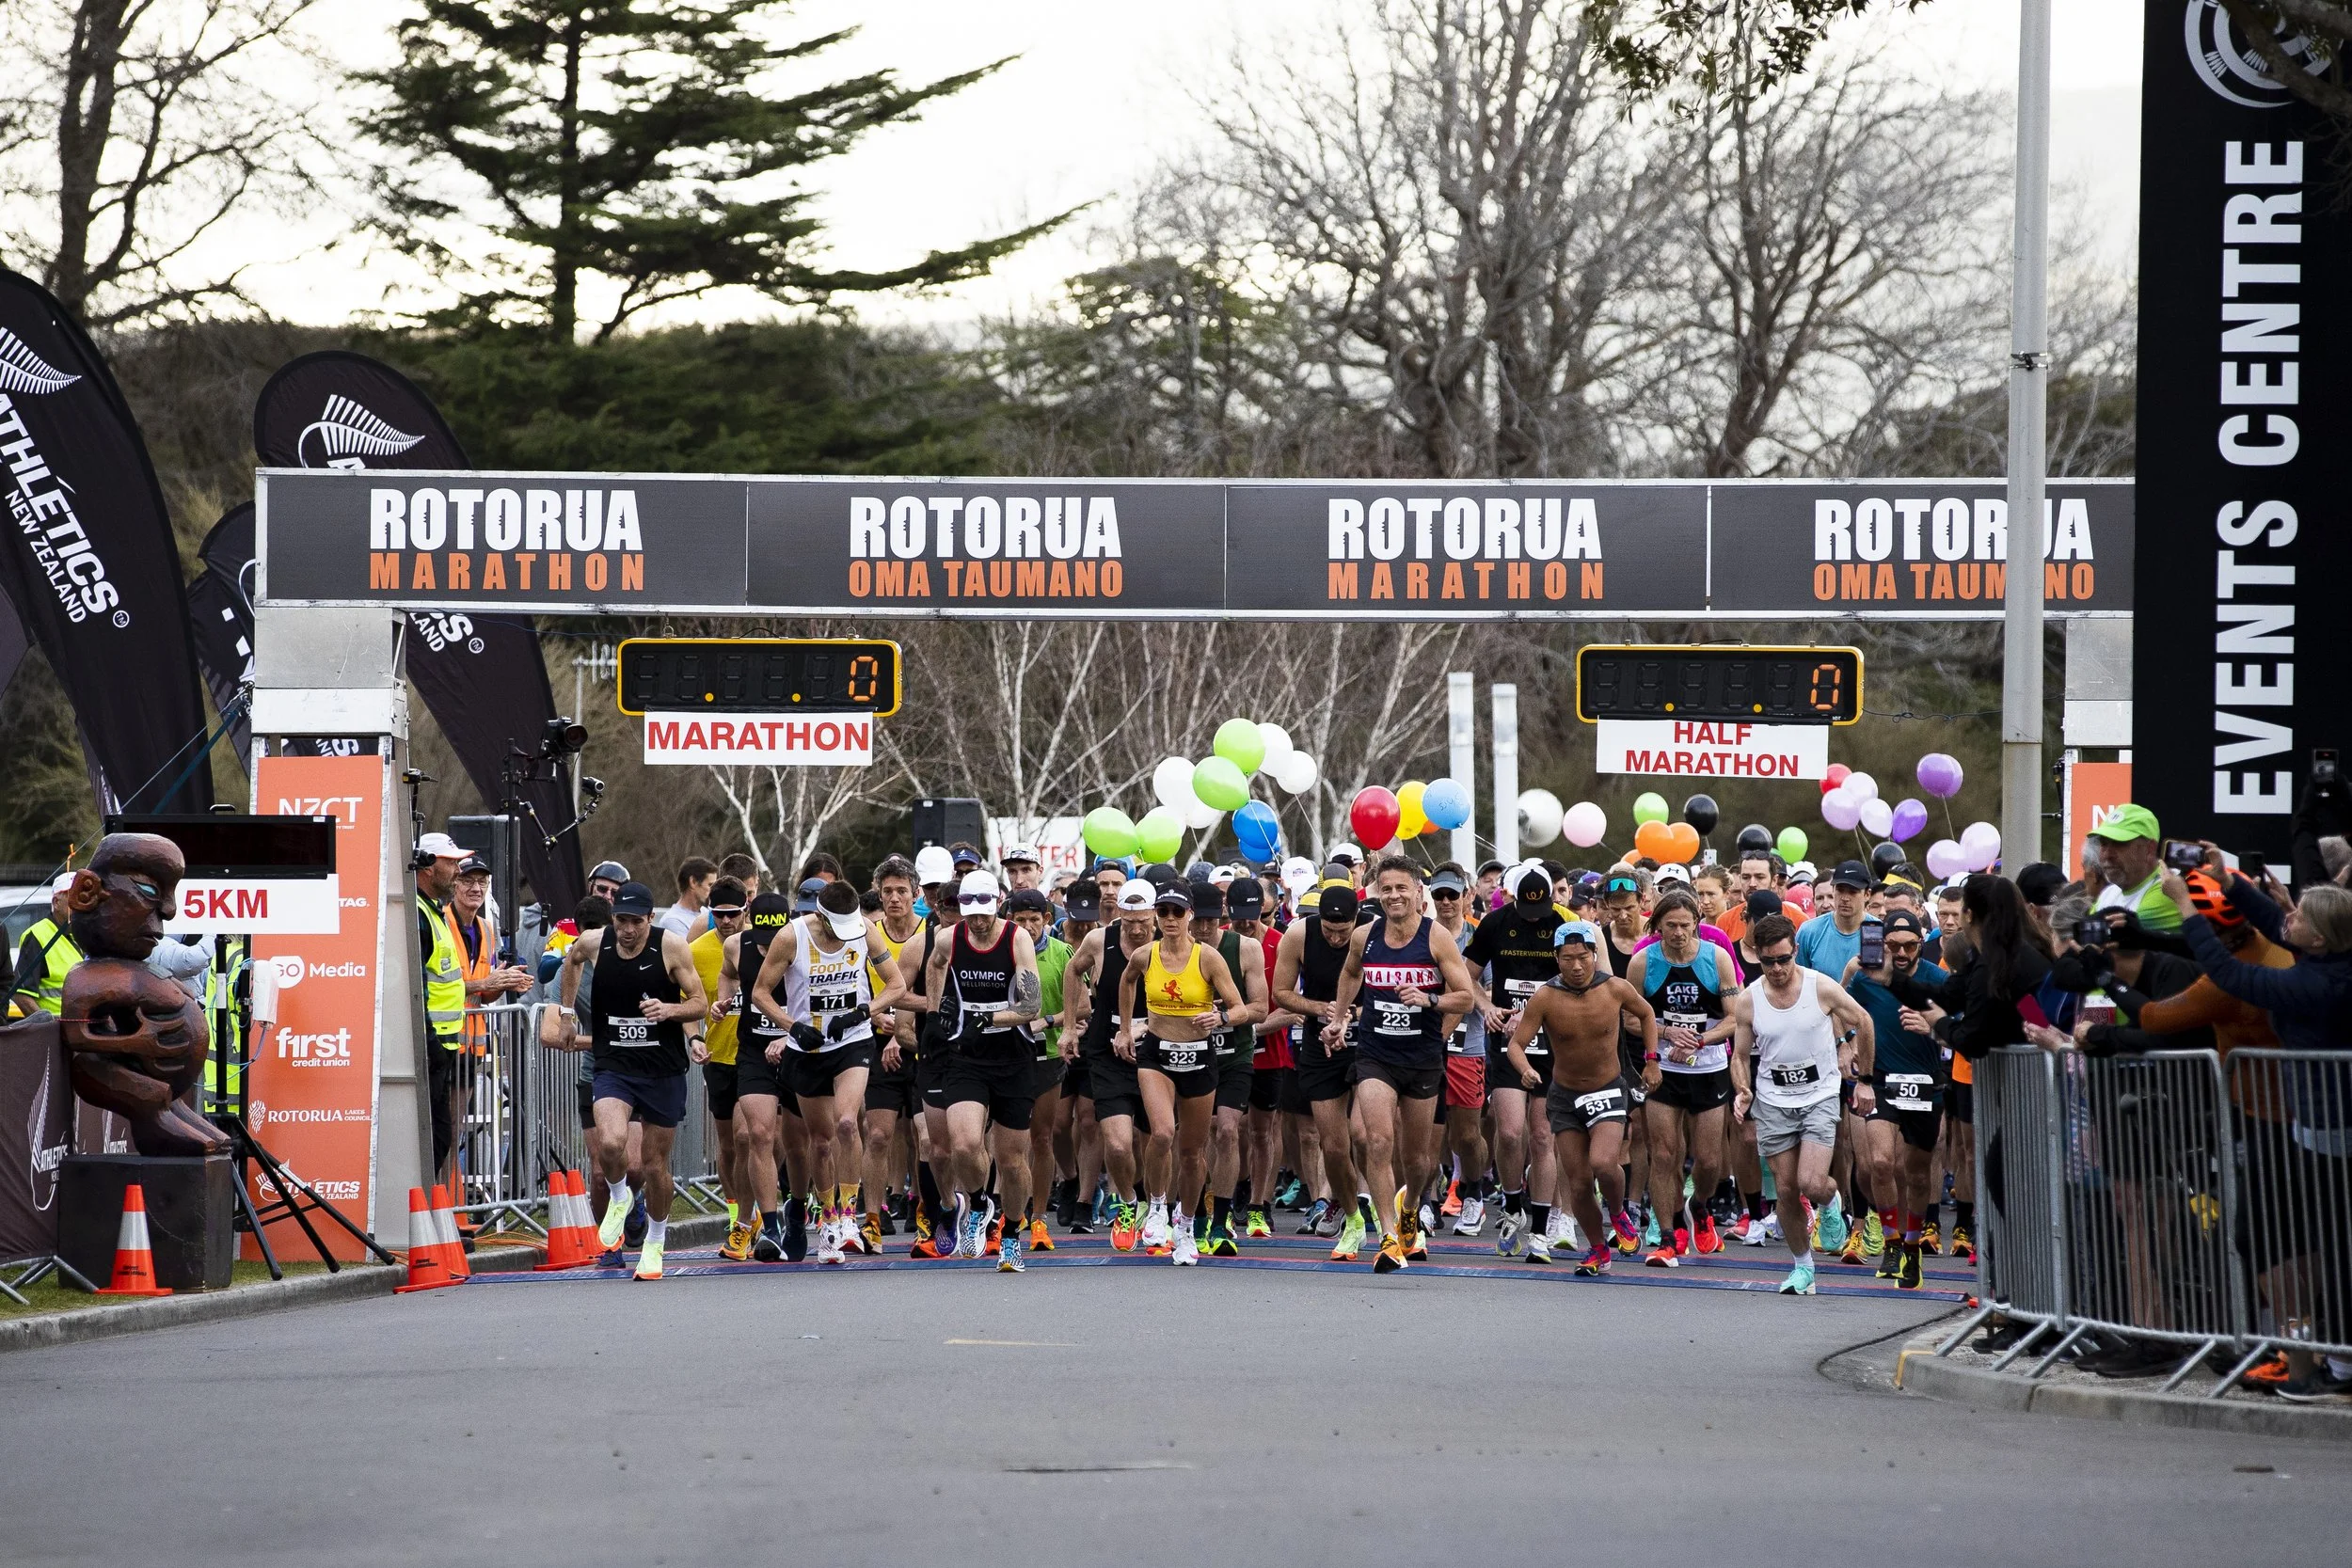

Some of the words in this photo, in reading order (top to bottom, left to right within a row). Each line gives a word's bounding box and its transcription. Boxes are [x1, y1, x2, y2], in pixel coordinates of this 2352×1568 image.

[2217, 140, 2304, 467] CENTRE
[370, 487, 643, 551] ROTORUA
[850, 496, 1122, 559] ROTORUA
[1327, 497, 1602, 561] ROTORUA
[1814, 497, 2094, 562] ROTORA
[5, 488, 40, 535] NEW
[30, 535, 87, 624] ZEALAND
[370, 552, 644, 591] MARATHON
[849, 561, 930, 597] OMA
[944, 561, 1123, 597] TAUMANO
[1327, 562, 1603, 600] MARATHON
[1814, 563, 1897, 600] OMA
[1910, 563, 2094, 600] TAUMNO
[2213, 499, 2298, 816] EVENTS
[849, 656, 878, 702] 0
[1810, 663, 1841, 710] 0
[648, 721, 868, 752] MARATHON
[1674, 721, 1753, 746] HALF
[1626, 750, 1799, 777] MARATHON
[183, 889, 268, 919] 5KM
[755, 912, 787, 926] CANN
[309, 961, 366, 978] Media
[809, 961, 845, 975] FOOT
[809, 969, 860, 985] TRAFFIC
[960, 970, 1006, 981] OLYMPIC
[961, 980, 1007, 989] WELLINGTON
[1666, 985, 1699, 995] LAKE
[820, 994, 846, 1009] 171
[1667, 995, 1699, 1005] CITY
[1382, 1012, 1411, 1027] 223
[618, 1025, 647, 1039] 509
[292, 1058, 321, 1068] credit
[322, 1058, 351, 1068] union
[1168, 1051, 1198, 1065] 323
[1781, 1069, 1808, 1084] 182
[1899, 1083, 1919, 1098] 50
[268, 1110, 342, 1123] ROTORUA
[1585, 1098, 1612, 1116] 531
